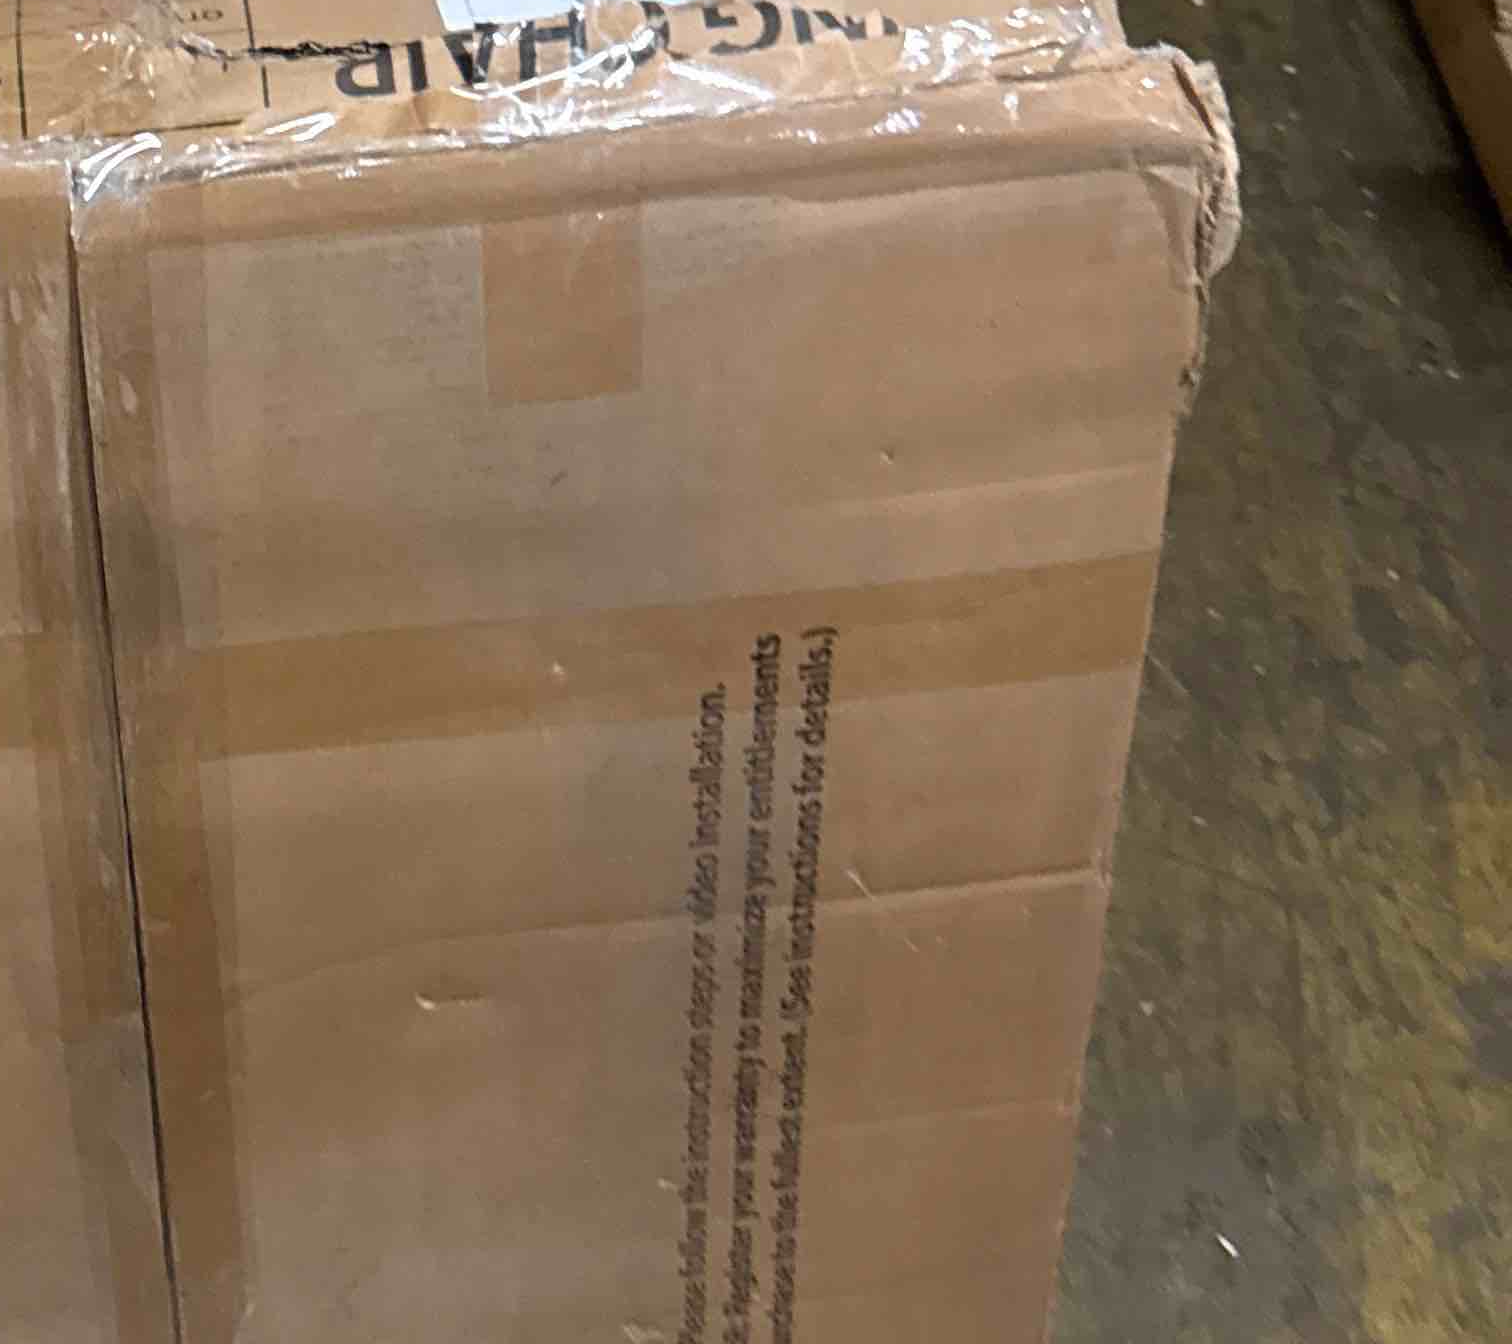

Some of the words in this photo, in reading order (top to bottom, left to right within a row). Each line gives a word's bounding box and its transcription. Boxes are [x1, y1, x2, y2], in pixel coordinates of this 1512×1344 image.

[792, 625, 840, 749] details.)
[739, 633, 781, 822] entitlements
[687, 681, 727, 849] installation.
[790, 754, 825, 797] for
[683, 852, 719, 926] video
[742, 826, 777, 892] your
[782, 799, 825, 962] instructions
[734, 894, 768, 1020] maximize
[682, 964, 719, 1031] steps
[733, 1024, 761, 1054] to
[681, 1033, 712, 1164] instruction
[731, 1056, 767, 1165] warranty
[677, 1167, 710, 1206] the
[731, 1168, 761, 1220] your
[676, 1209, 707, 1279] follow
